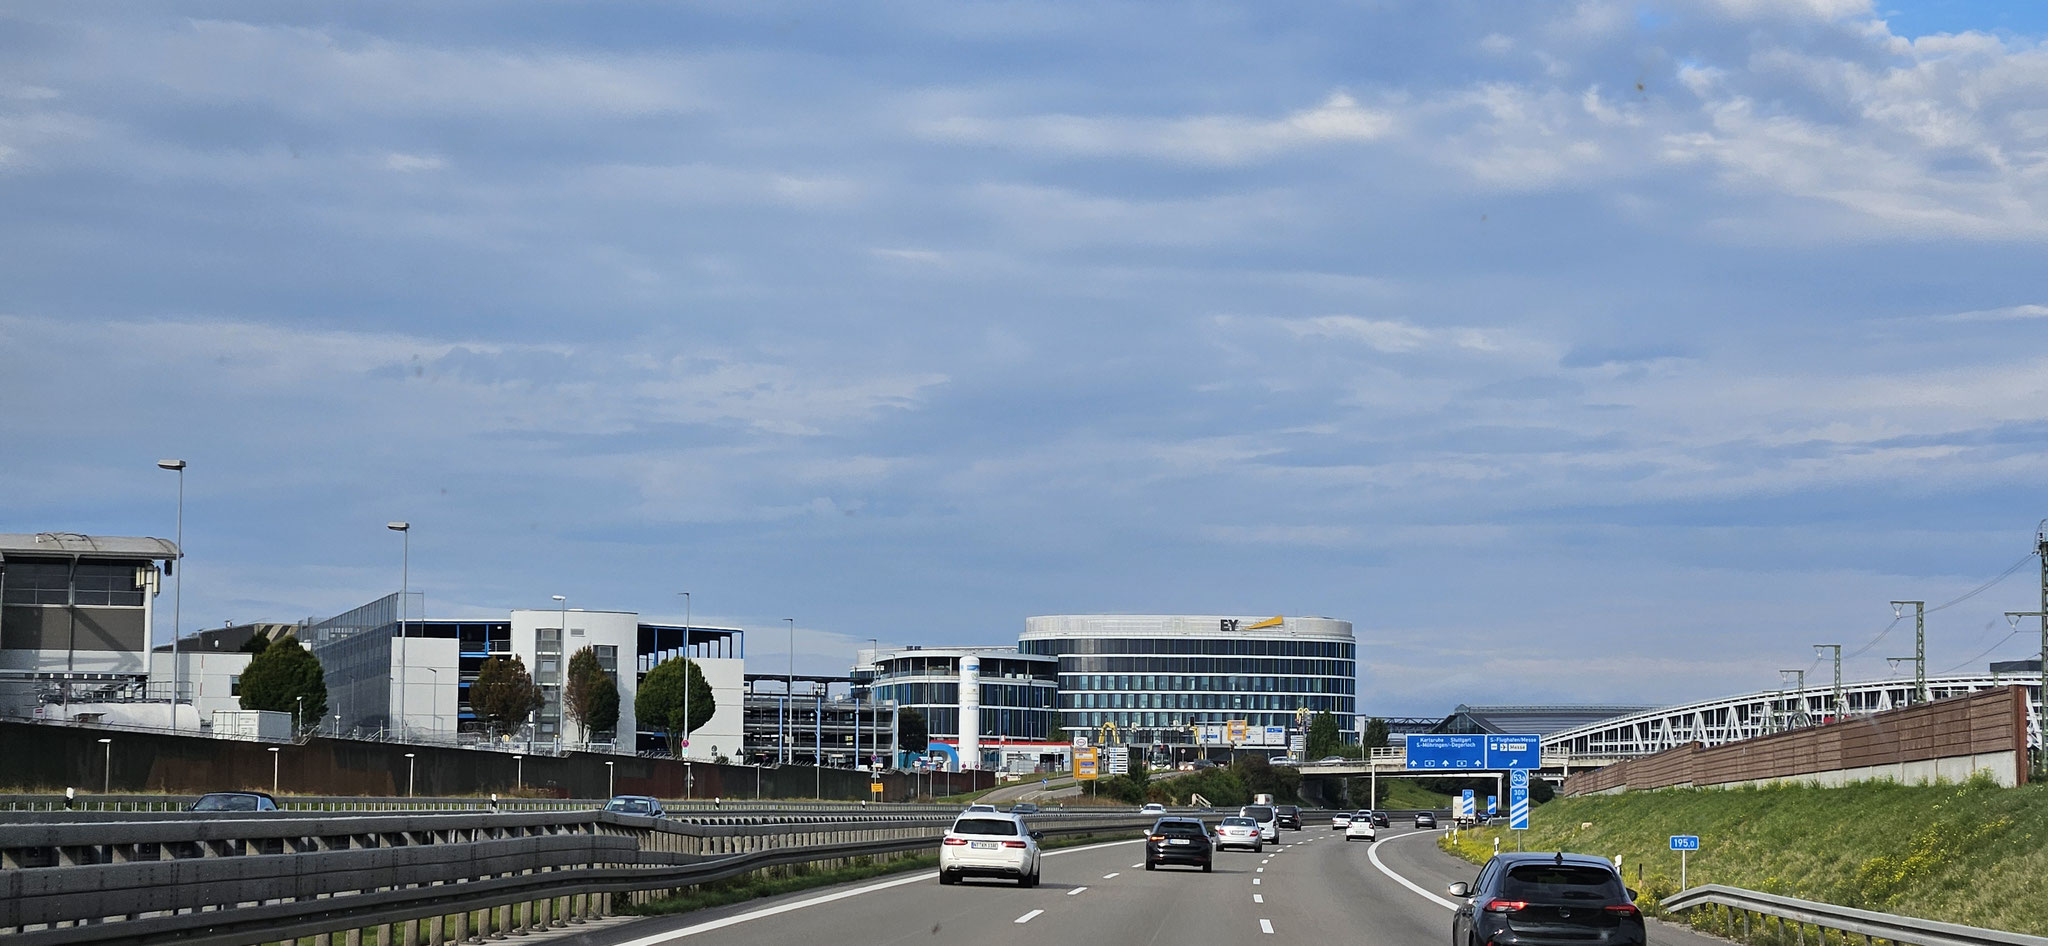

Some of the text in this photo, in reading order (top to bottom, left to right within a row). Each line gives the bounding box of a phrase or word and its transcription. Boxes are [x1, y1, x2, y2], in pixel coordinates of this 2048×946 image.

[1220, 619, 1239, 632] EY
[1513, 774, 1526, 782] 53a
[1674, 838, 1695, 848] 195.0
